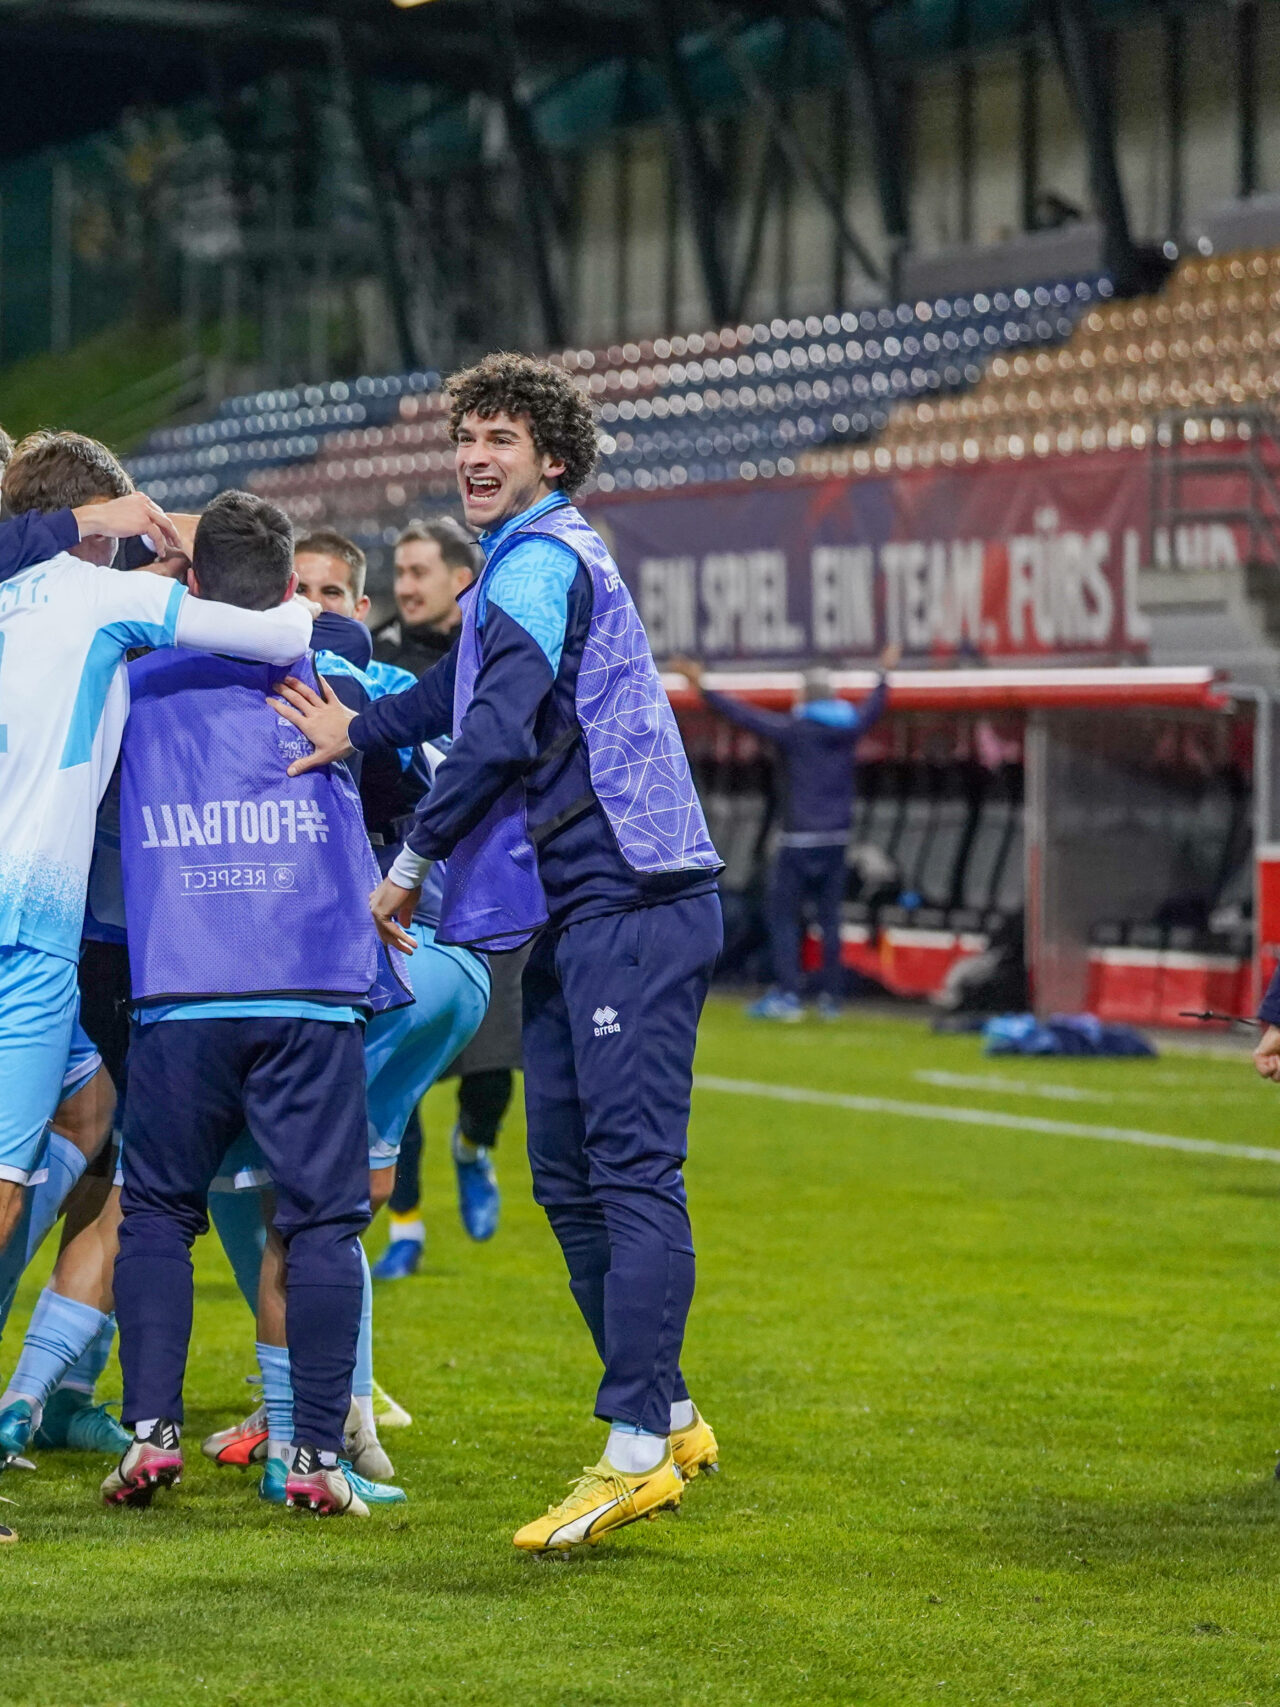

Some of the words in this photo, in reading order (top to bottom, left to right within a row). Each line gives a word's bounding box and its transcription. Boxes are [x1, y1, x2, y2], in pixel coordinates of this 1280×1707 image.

[640, 555, 696, 653] EIN
[701, 547, 807, 651] SPIEL.
[811, 543, 874, 649] EIN
[878, 537, 997, 648] TEAM.
[1007, 504, 1112, 648] FÜRS
[593, 1023, 621, 1037] errea
